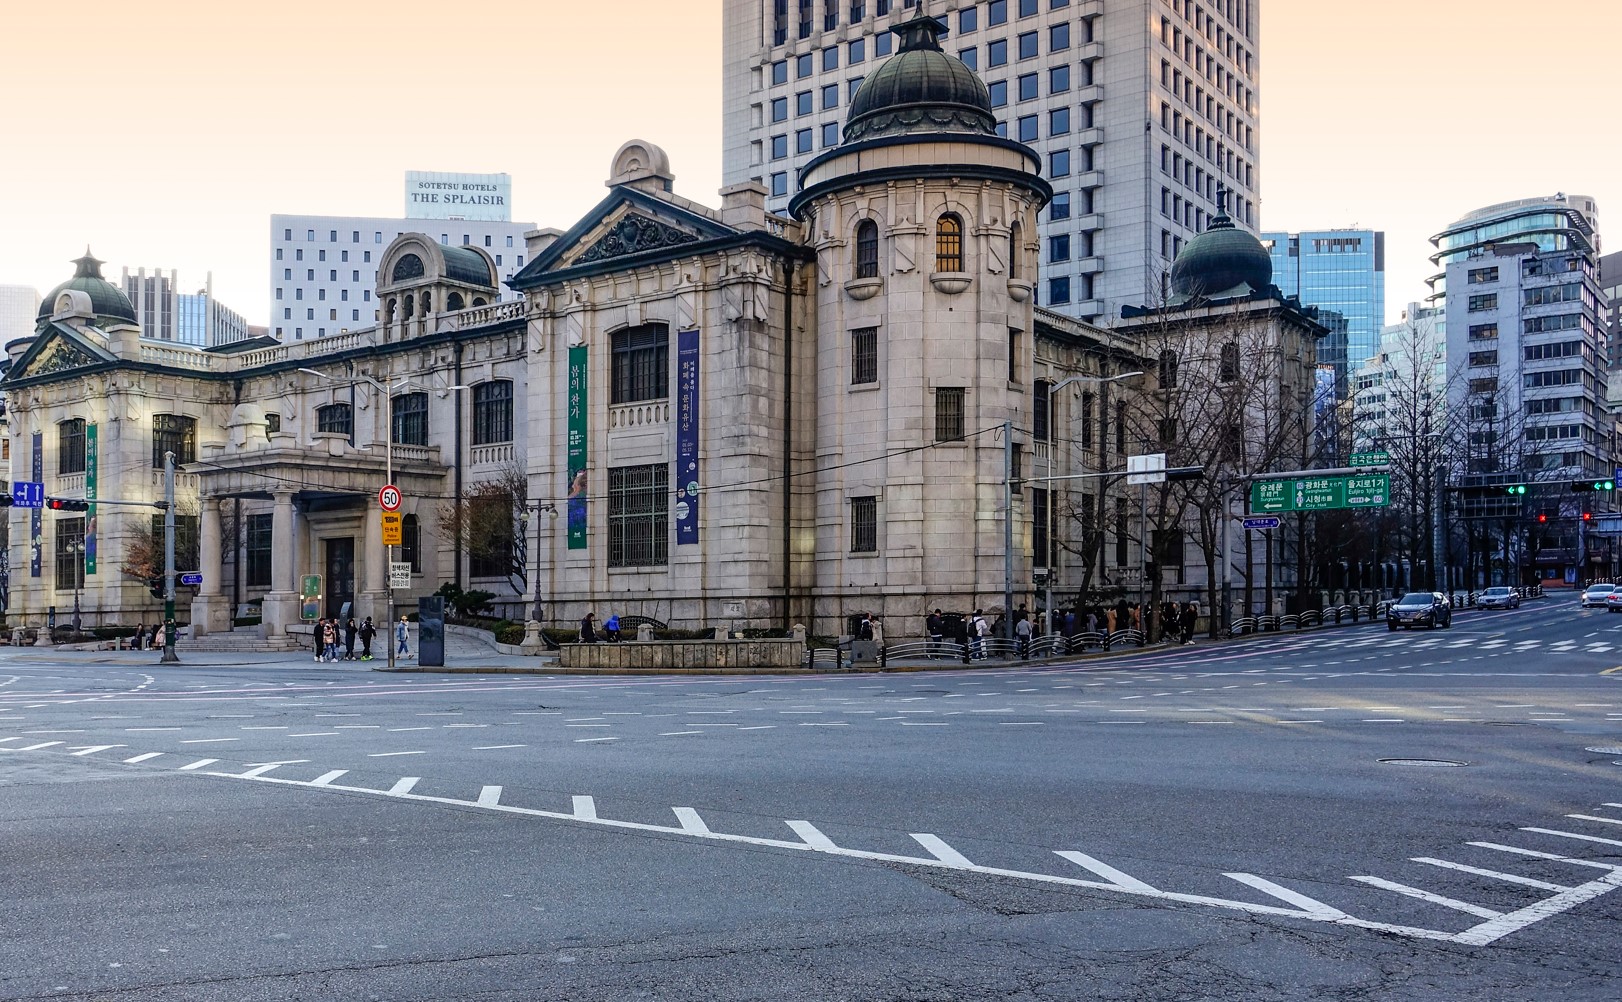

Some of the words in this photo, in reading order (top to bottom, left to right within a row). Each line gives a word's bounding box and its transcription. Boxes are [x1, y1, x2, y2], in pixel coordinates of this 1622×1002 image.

[418, 182, 459, 191] SOTETSU
[462, 183, 498, 192] HOTELS
[412, 193, 439, 203] THE
[443, 193, 505, 205] SPLAISIR
[571, 364, 580, 391] 봄의
[571, 392, 580, 419] 찬가
[1260, 483, 1283, 492] 숭례문
[1305, 480, 1329, 489] 광화문
[1347, 479, 1385, 489] 을지로1가
[384, 492, 397, 505] 50
[1305, 495, 1321, 503] 시청
